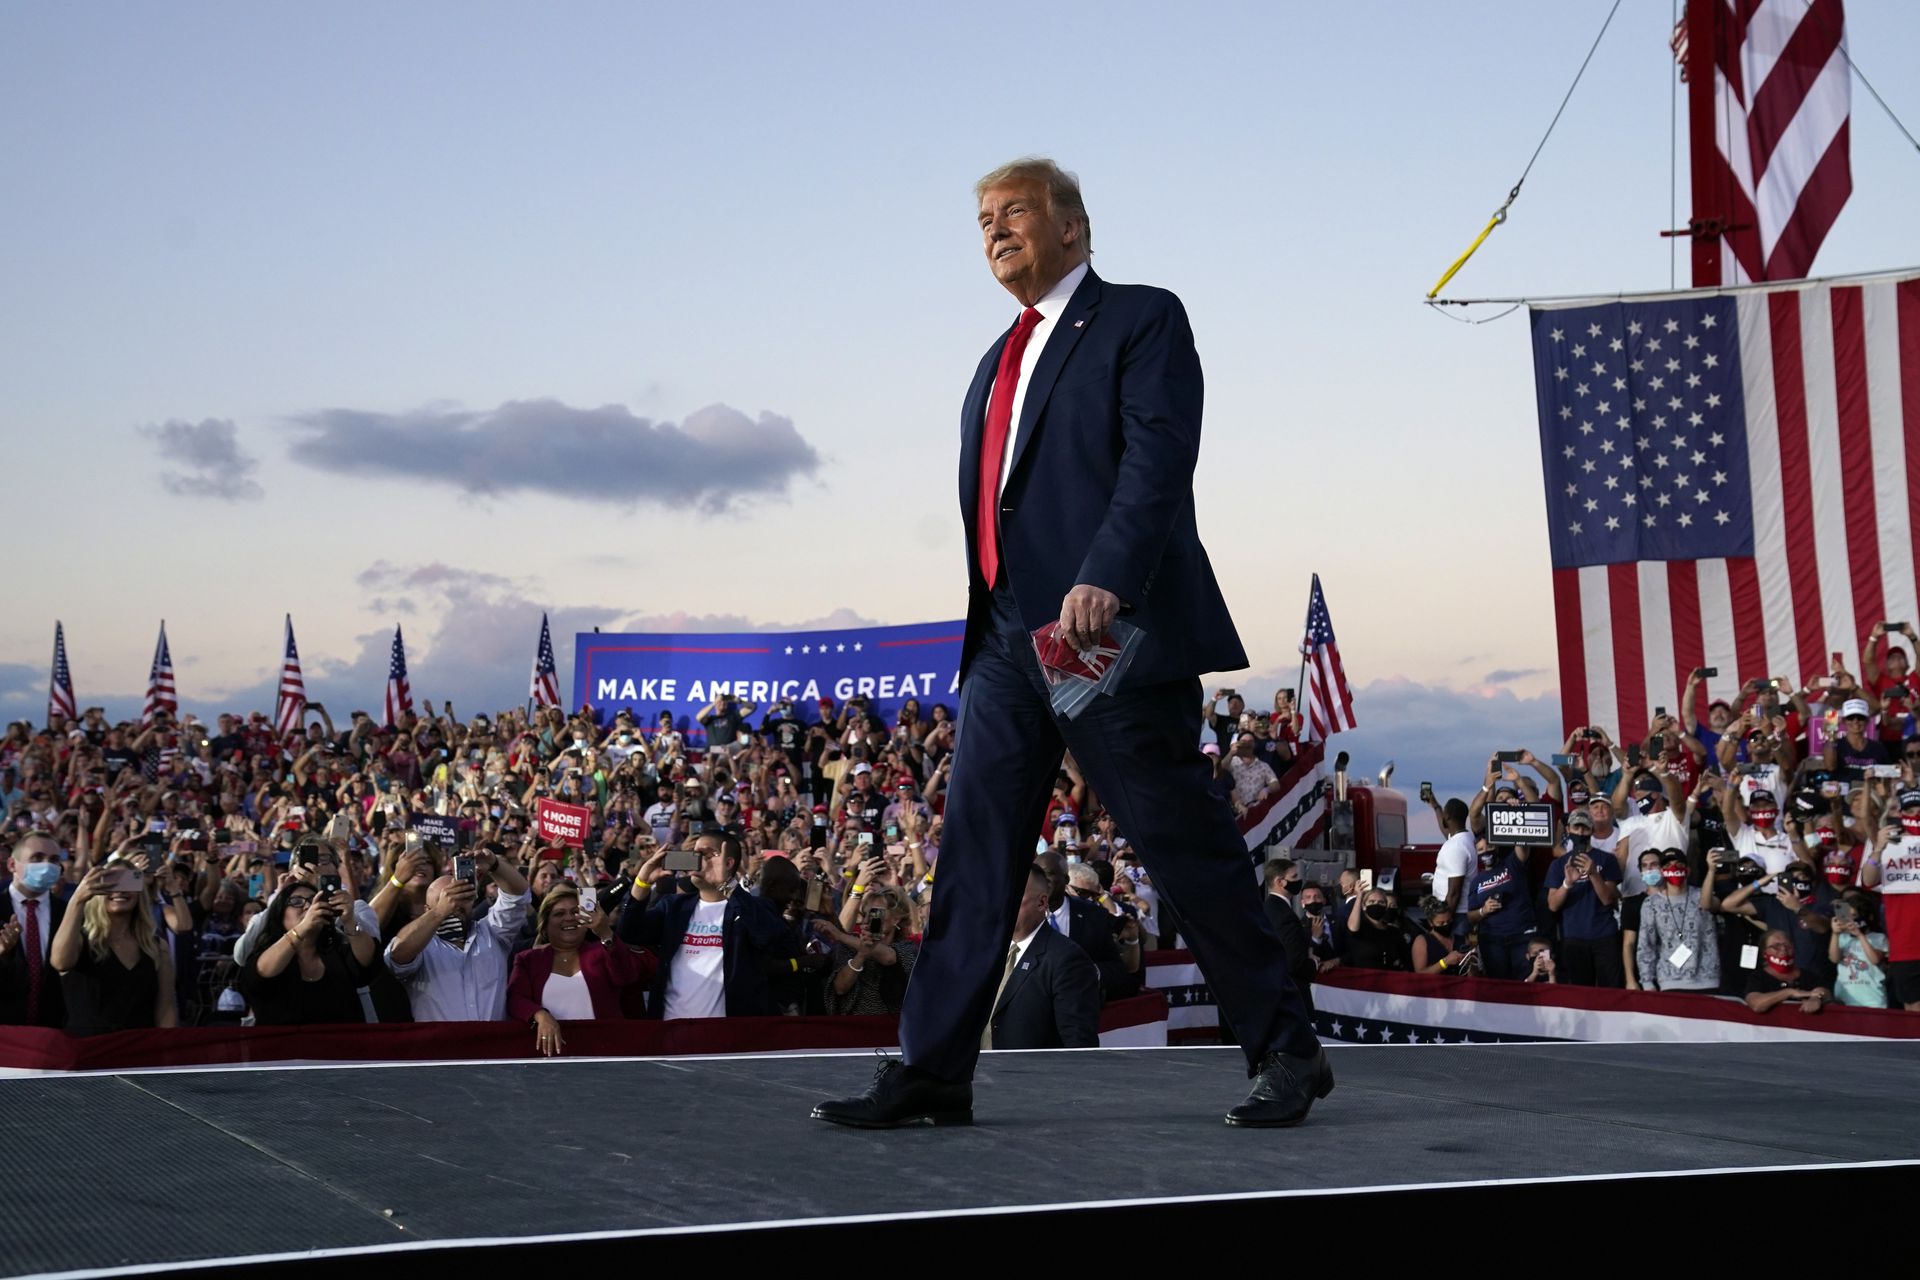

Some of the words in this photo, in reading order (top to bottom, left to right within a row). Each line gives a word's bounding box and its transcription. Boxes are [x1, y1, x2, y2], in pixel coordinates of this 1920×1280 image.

[597, 678, 677, 701] MAKE
[687, 679, 822, 703] AMERICA
[834, 672, 937, 701] GREAT
[542, 809, 550, 819] 4
[550, 811, 582, 826] MORE
[1492, 811, 1524, 825] COPS
[543, 821, 580, 838] YEARS!
[1516, 827, 1547, 835] TRUMP
[692, 937, 723, 945] TRUMP
